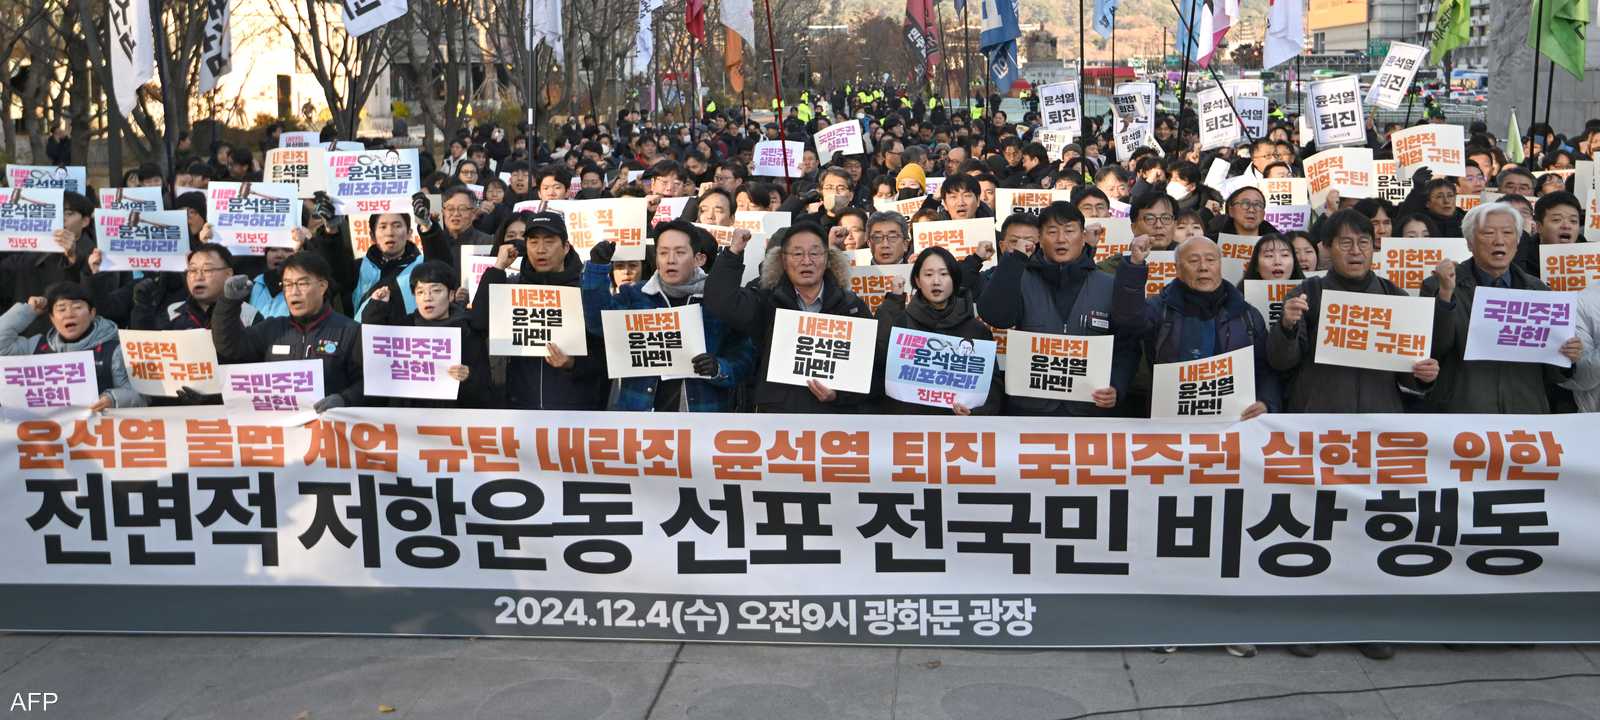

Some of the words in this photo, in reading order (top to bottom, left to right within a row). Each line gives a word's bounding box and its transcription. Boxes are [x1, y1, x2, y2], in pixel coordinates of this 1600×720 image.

[1044, 92, 1076, 106] 윤석열
[1315, 91, 1355, 108] 윤석열
[1048, 108, 1076, 124] 퇴진
[1205, 113, 1233, 132] 퇴진
[1320, 110, 1356, 130] 퇴진
[1396, 133, 1436, 150] 위헌적
[1307, 156, 1343, 179] 위헌적
[1397, 148, 1423, 168] 계엄
[1428, 148, 1461, 164] 규탄!
[349, 164, 412, 181] 윤석열을
[1334, 170, 1368, 186] 규탄!
[338, 181, 408, 195] 체포하라!
[1267, 181, 1292, 193] 란죄
[229, 198, 290, 213] 윤석열을
[357, 200, 390, 211] 진보당
[1269, 194, 1292, 205] 석열
[1, 203, 56, 218] 윤석열을
[1265, 212, 1305, 228] 민주권
[218, 213, 286, 228] 탄핵하라!
[8, 236, 38, 248] 진보당
[119, 225, 181, 240] 윤석열을
[236, 232, 267, 244] 진보당
[918, 230, 964, 248] 위헌적
[111, 239, 177, 252] 탄핵하라!
[1222, 243, 1255, 259] 위헌
[128, 257, 161, 268] 진보당
[1387, 249, 1442, 269] 위헌적
[1387, 270, 1424, 289] 계엄
[511, 289, 562, 307] 내란죄
[511, 308, 563, 327] 윤석열
[624, 311, 680, 332] 내란죄
[1327, 303, 1392, 329] 위헌적
[1483, 299, 1570, 327] 국민주권
[796, 315, 854, 339] 내란죄
[511, 328, 552, 346] 파면!
[628, 331, 683, 350] 윤석열
[896, 333, 928, 349] 내란
[1031, 336, 1089, 357] 내란죄
[1323, 326, 1369, 351] 계엄
[1374, 331, 1427, 357] 규탄!
[1496, 325, 1550, 349] 실현!
[125, 341, 178, 361] 위헌적
[372, 335, 452, 360] 국민주권
[795, 336, 851, 360] 윤석열
[630, 350, 673, 368] 파면!
[792, 356, 837, 380] 파면!
[913, 348, 986, 375] 윤석열을
[1030, 354, 1087, 377] 윤석열
[4, 362, 87, 387] 국민주권
[129, 361, 165, 380] 계엄
[169, 361, 213, 382] 규탄!
[389, 360, 436, 382] 실현!
[898, 364, 980, 390] 체포하라!
[1178, 356, 1233, 382] 내란죄
[231, 371, 315, 394] 국민주권
[1029, 374, 1073, 393] 파면!
[1177, 375, 1235, 400] 윤석열
[25, 386, 71, 408] 실현!
[252, 394, 300, 411] 실현!
[917, 388, 957, 405] 진보당
[1176, 399, 1222, 416] 파면!
[16, 418, 167, 469] 윤석열
[185, 418, 285, 468] 불법
[303, 420, 399, 472] 계엄
[416, 425, 520, 472] 규탄
[535, 427, 693, 479] 내란죄
[712, 429, 871, 483] 윤석열
[891, 431, 997, 485] 퇴진
[1018, 432, 1241, 485] 국민주권
[1261, 429, 1429, 486] 실현을
[1449, 429, 1565, 482] 위한
[25, 472, 279, 566] 전면적
[297, 474, 643, 575] 저항운동
[660, 484, 841, 575] 선포
[856, 488, 1130, 576] 전국민
[1156, 488, 1348, 578] 비상
[1364, 487, 1560, 577] 행동
[494, 596, 729, 635] 2024.12.4(수)
[737, 599, 857, 636] 오전9시
[863, 599, 961, 637] 광화문
[968, 598, 1037, 637] 광장
